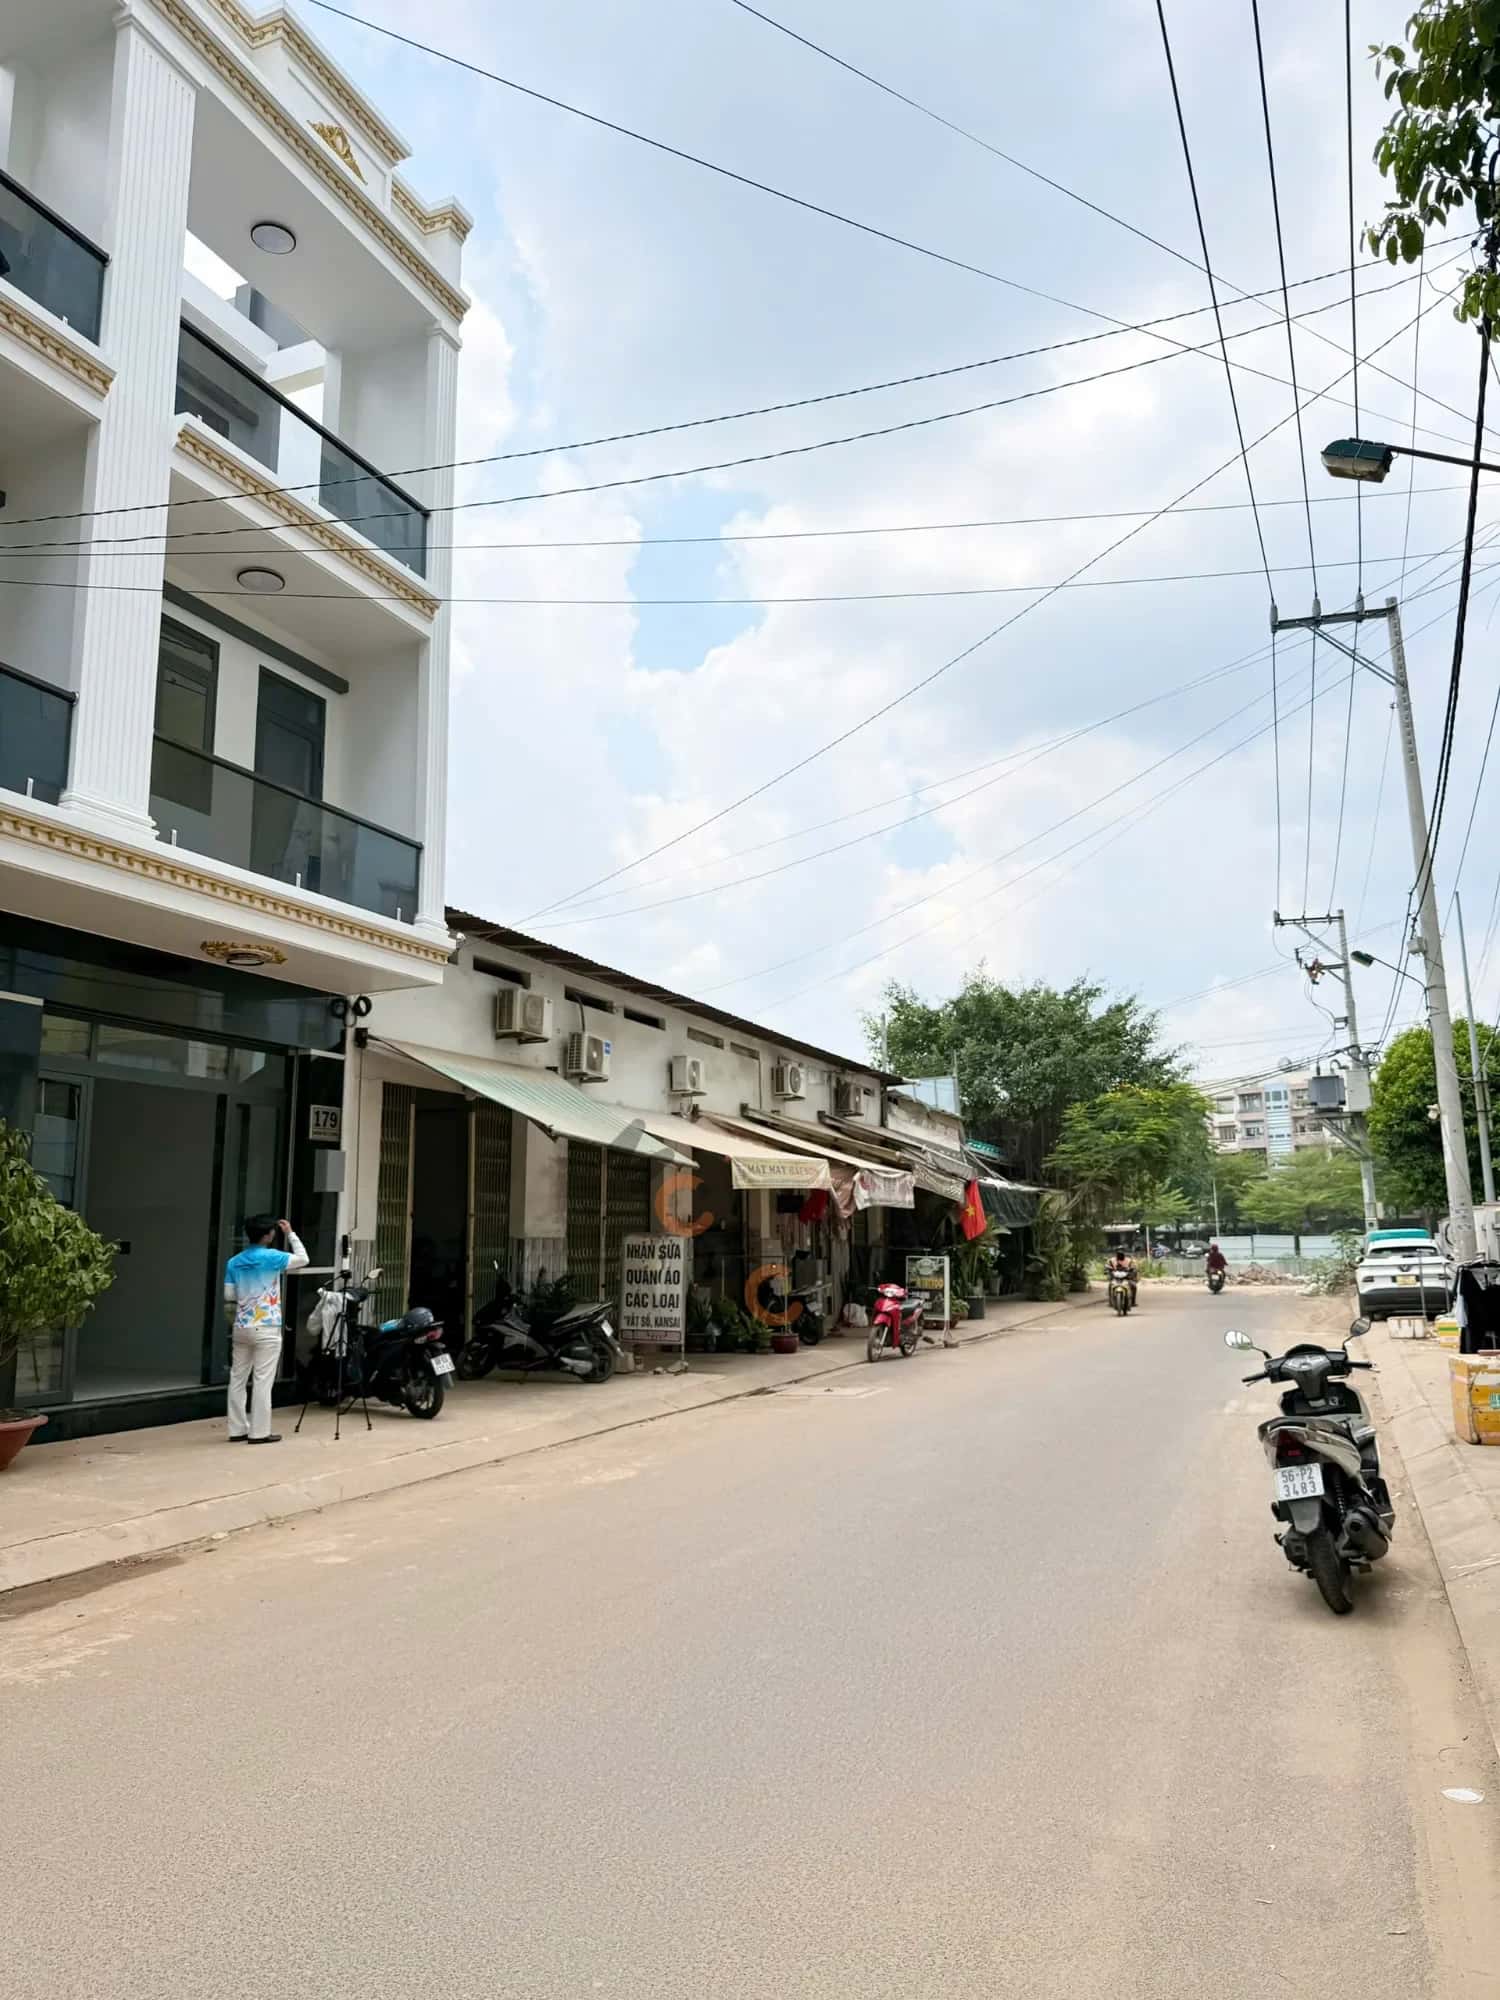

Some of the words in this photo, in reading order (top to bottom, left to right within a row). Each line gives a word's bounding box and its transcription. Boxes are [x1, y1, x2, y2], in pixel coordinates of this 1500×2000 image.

[314, 1110, 337, 1128] 179
[658, 1239, 681, 1260] SỬA
[626, 1289, 649, 1308] CÁC
[652, 1293, 680, 1312] LOẠI
[1283, 1481, 1317, 1498] 3483
